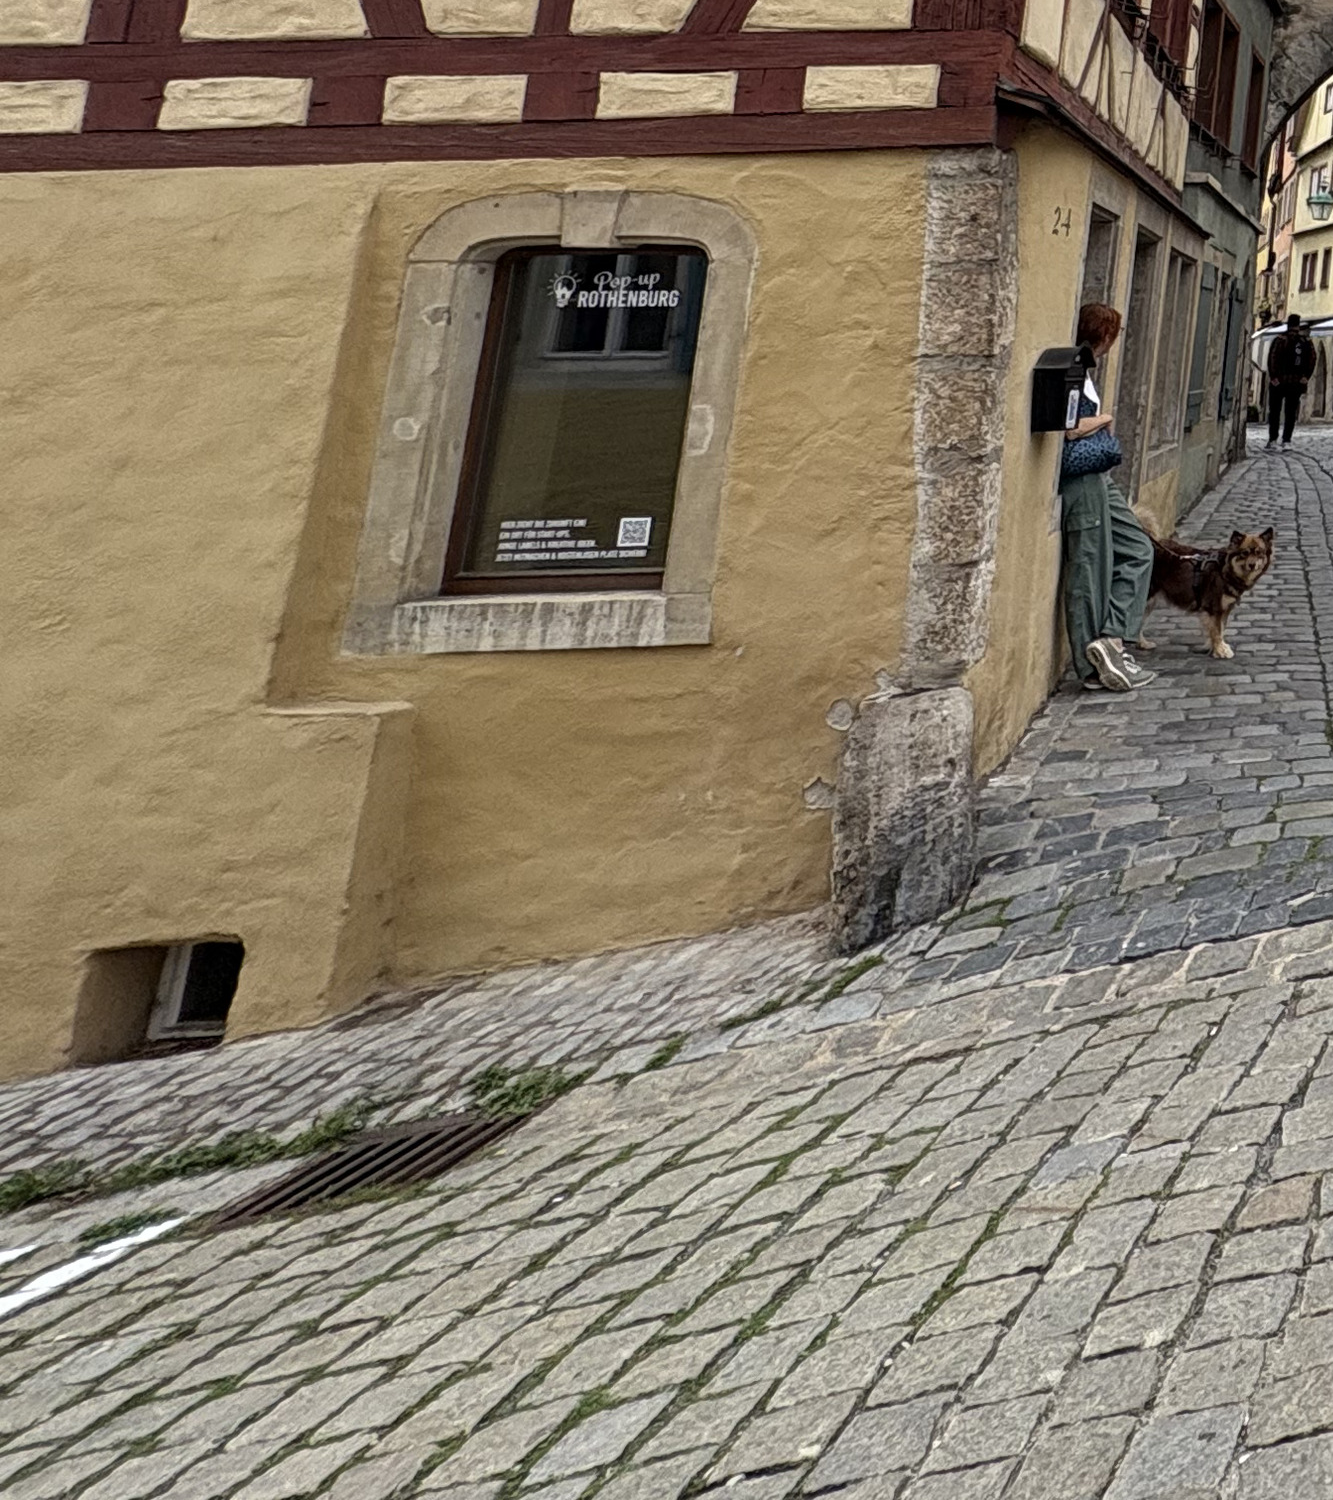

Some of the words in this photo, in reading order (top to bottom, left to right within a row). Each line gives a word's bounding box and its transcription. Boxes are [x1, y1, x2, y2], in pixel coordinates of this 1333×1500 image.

[1052, 206, 1072, 237] 24
[594, 271, 660, 292] Pop-up
[577, 290, 680, 308] ROTHENBURG
